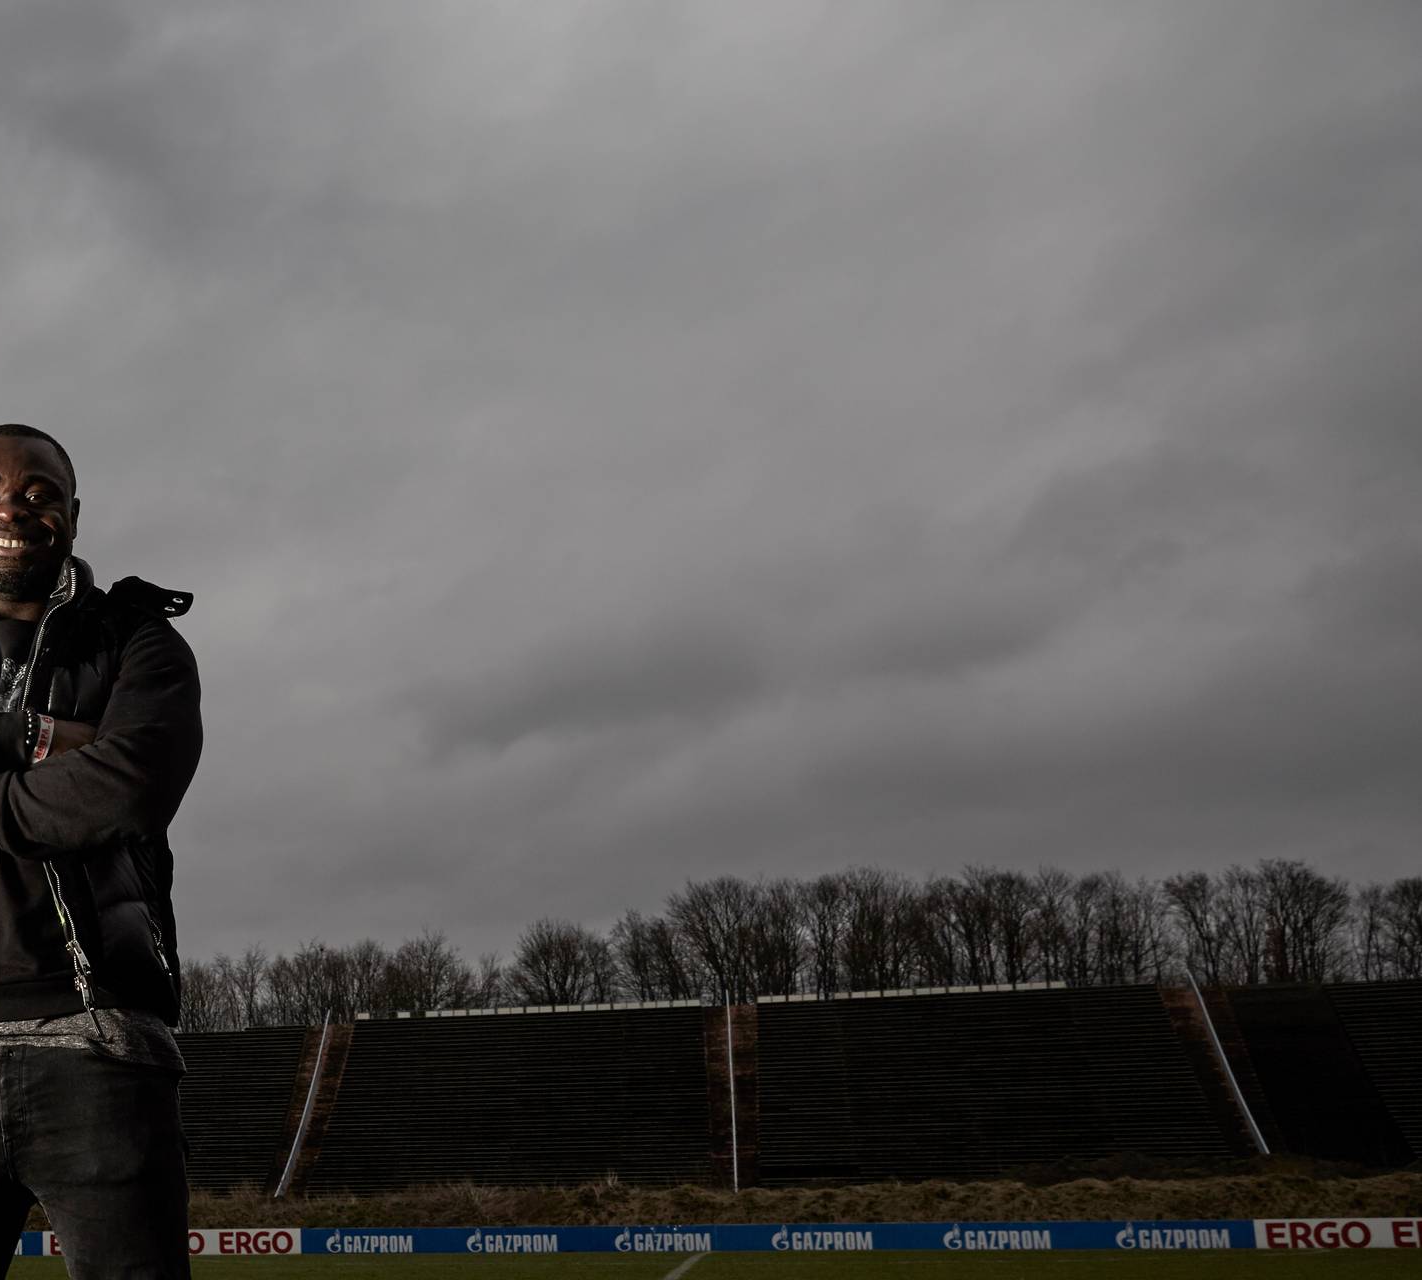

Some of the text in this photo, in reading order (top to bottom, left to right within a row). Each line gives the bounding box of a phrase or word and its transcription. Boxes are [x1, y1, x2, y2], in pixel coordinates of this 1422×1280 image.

[218, 1231, 293, 1254] ERGO
[343, 1228, 1231, 1254] GAZPROM GAZPROM GAZPROM GAZPROM GAZPROM GAZPROM
[1265, 1221, 1371, 1249] ERGO
